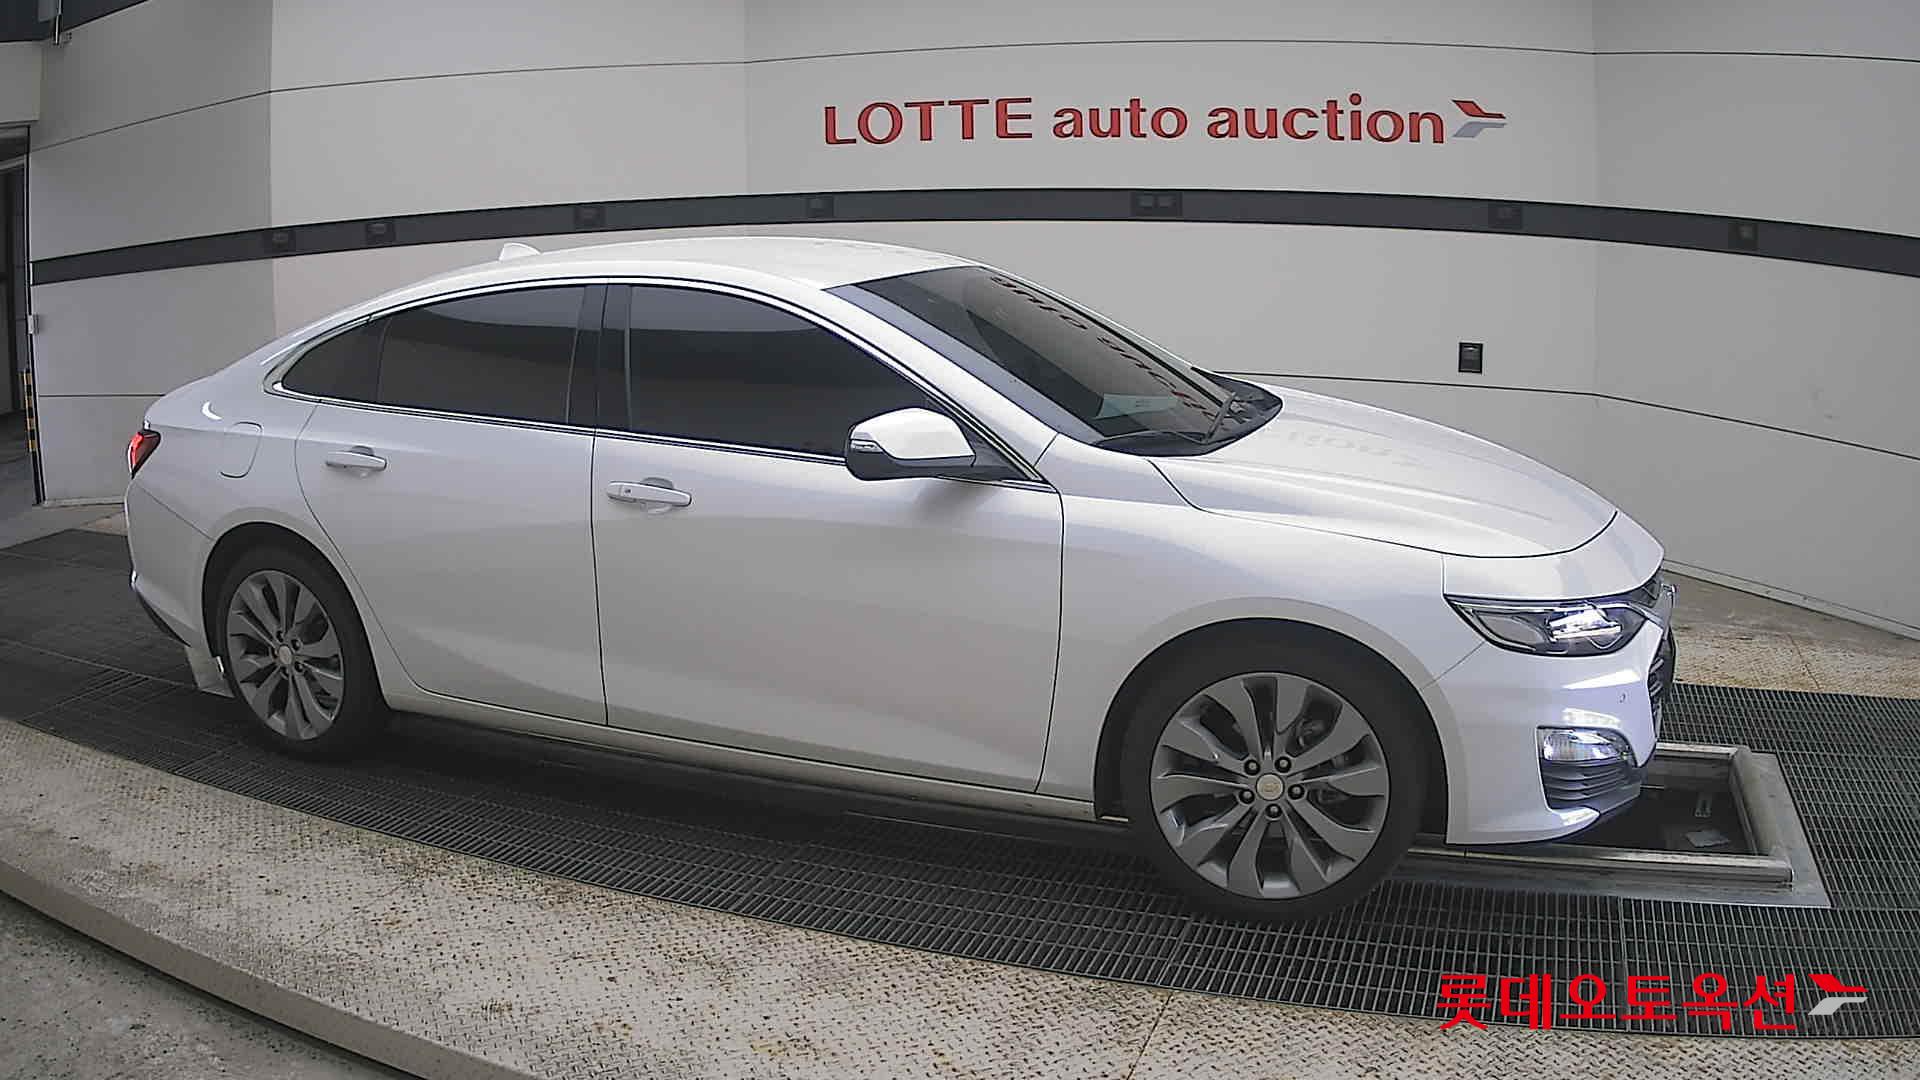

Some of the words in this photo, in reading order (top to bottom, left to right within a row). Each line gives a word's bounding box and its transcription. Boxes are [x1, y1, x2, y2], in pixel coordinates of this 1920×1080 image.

[823, 97, 1033, 146] LOTTE
[1052, 97, 1189, 140] auto
[1205, 93, 1446, 145] auction
